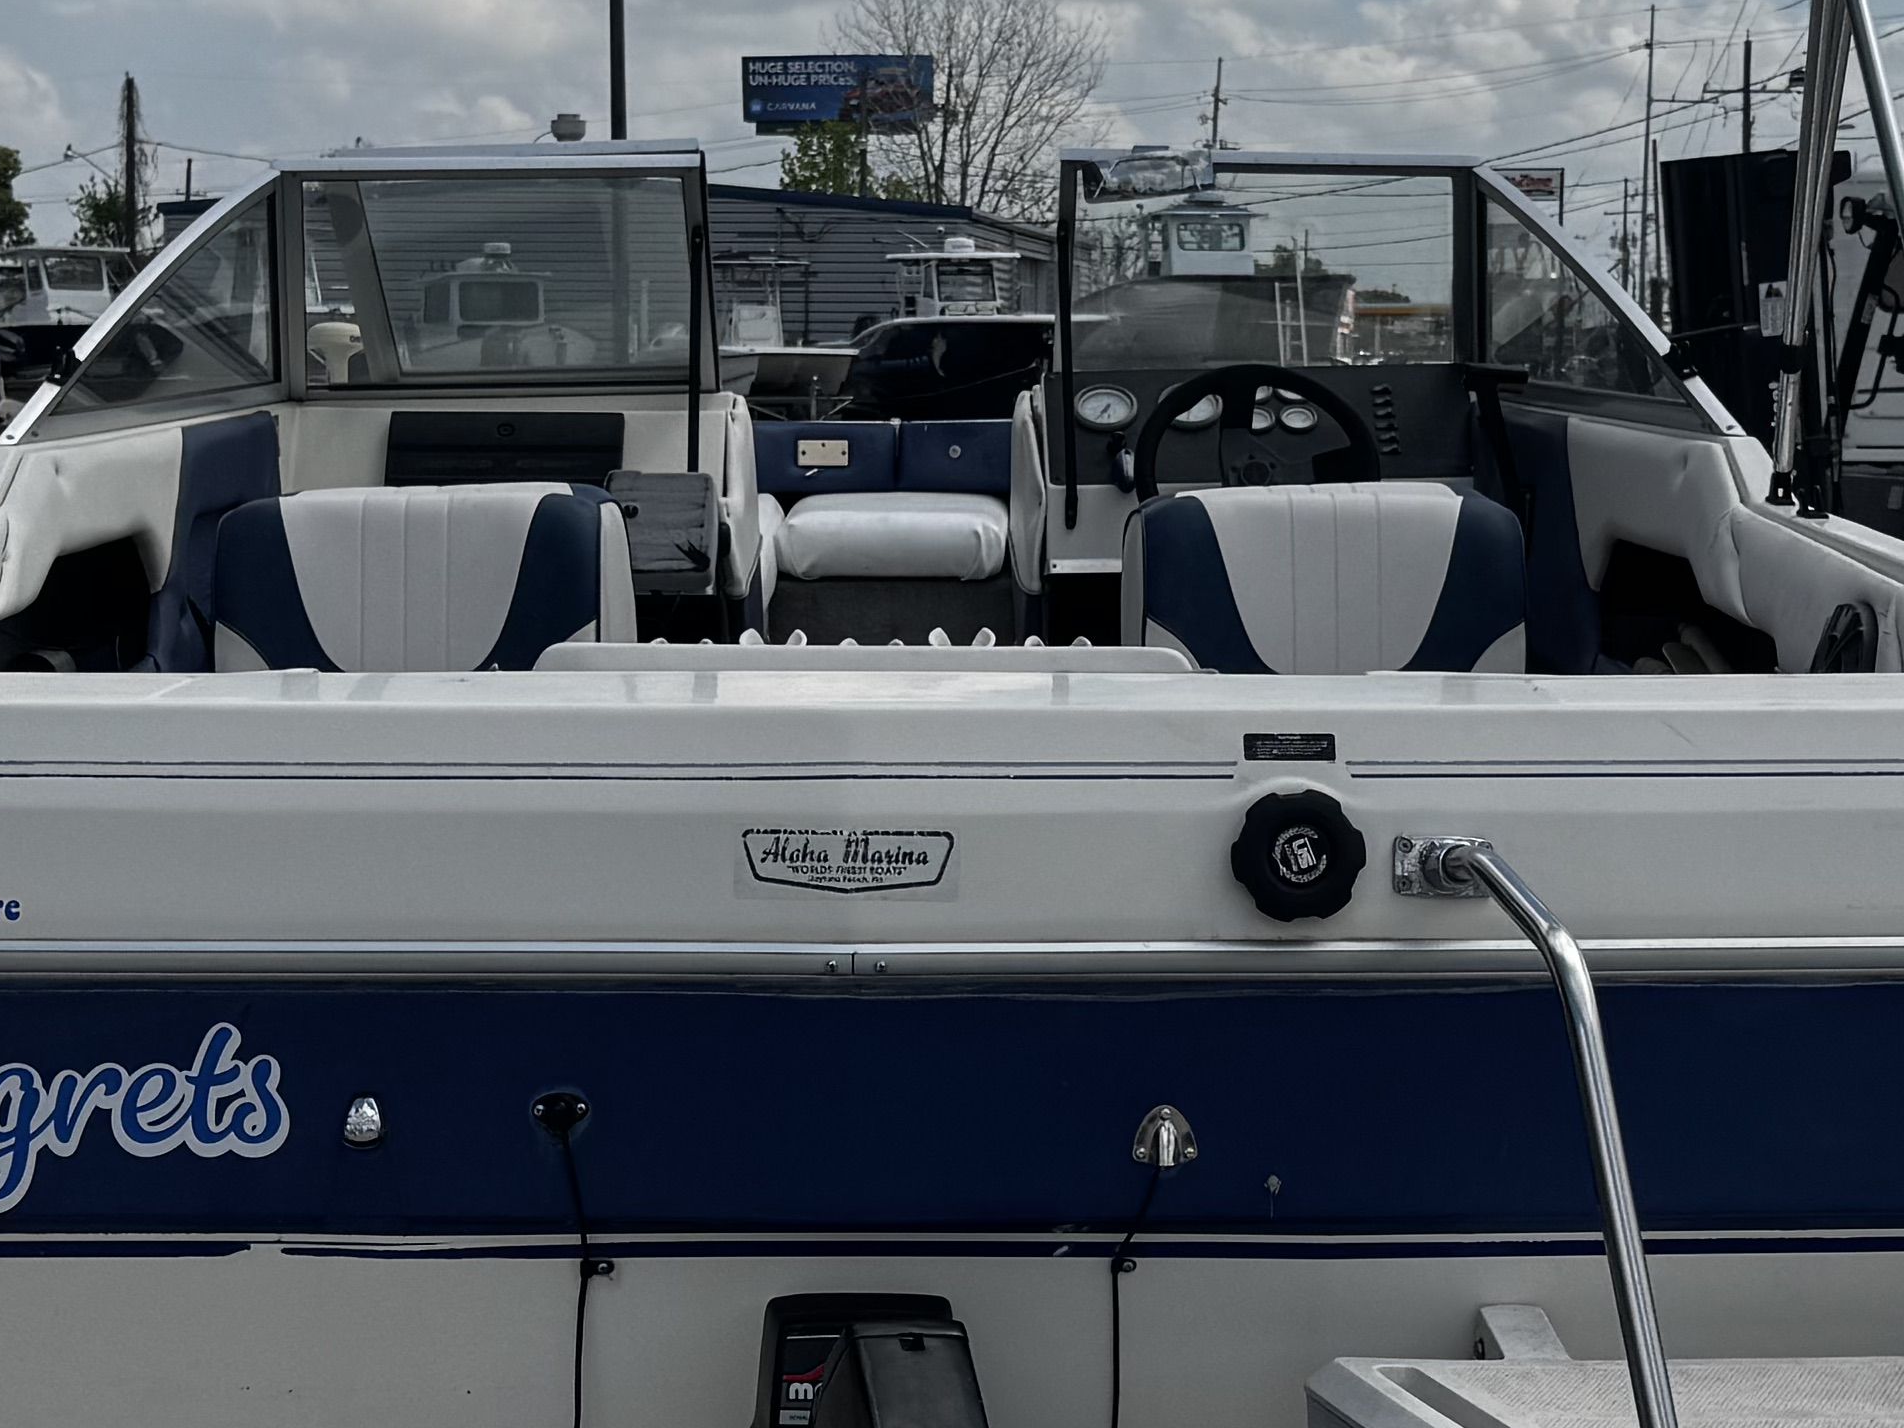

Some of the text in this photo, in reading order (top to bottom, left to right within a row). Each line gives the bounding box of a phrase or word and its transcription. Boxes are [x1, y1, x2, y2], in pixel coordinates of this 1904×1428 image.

[749, 61, 784, 73] HUGE
[749, 74, 807, 86] UN-HUGE
[766, 102, 817, 111] CARVANA
[760, 835, 929, 865] Aloha Marina
